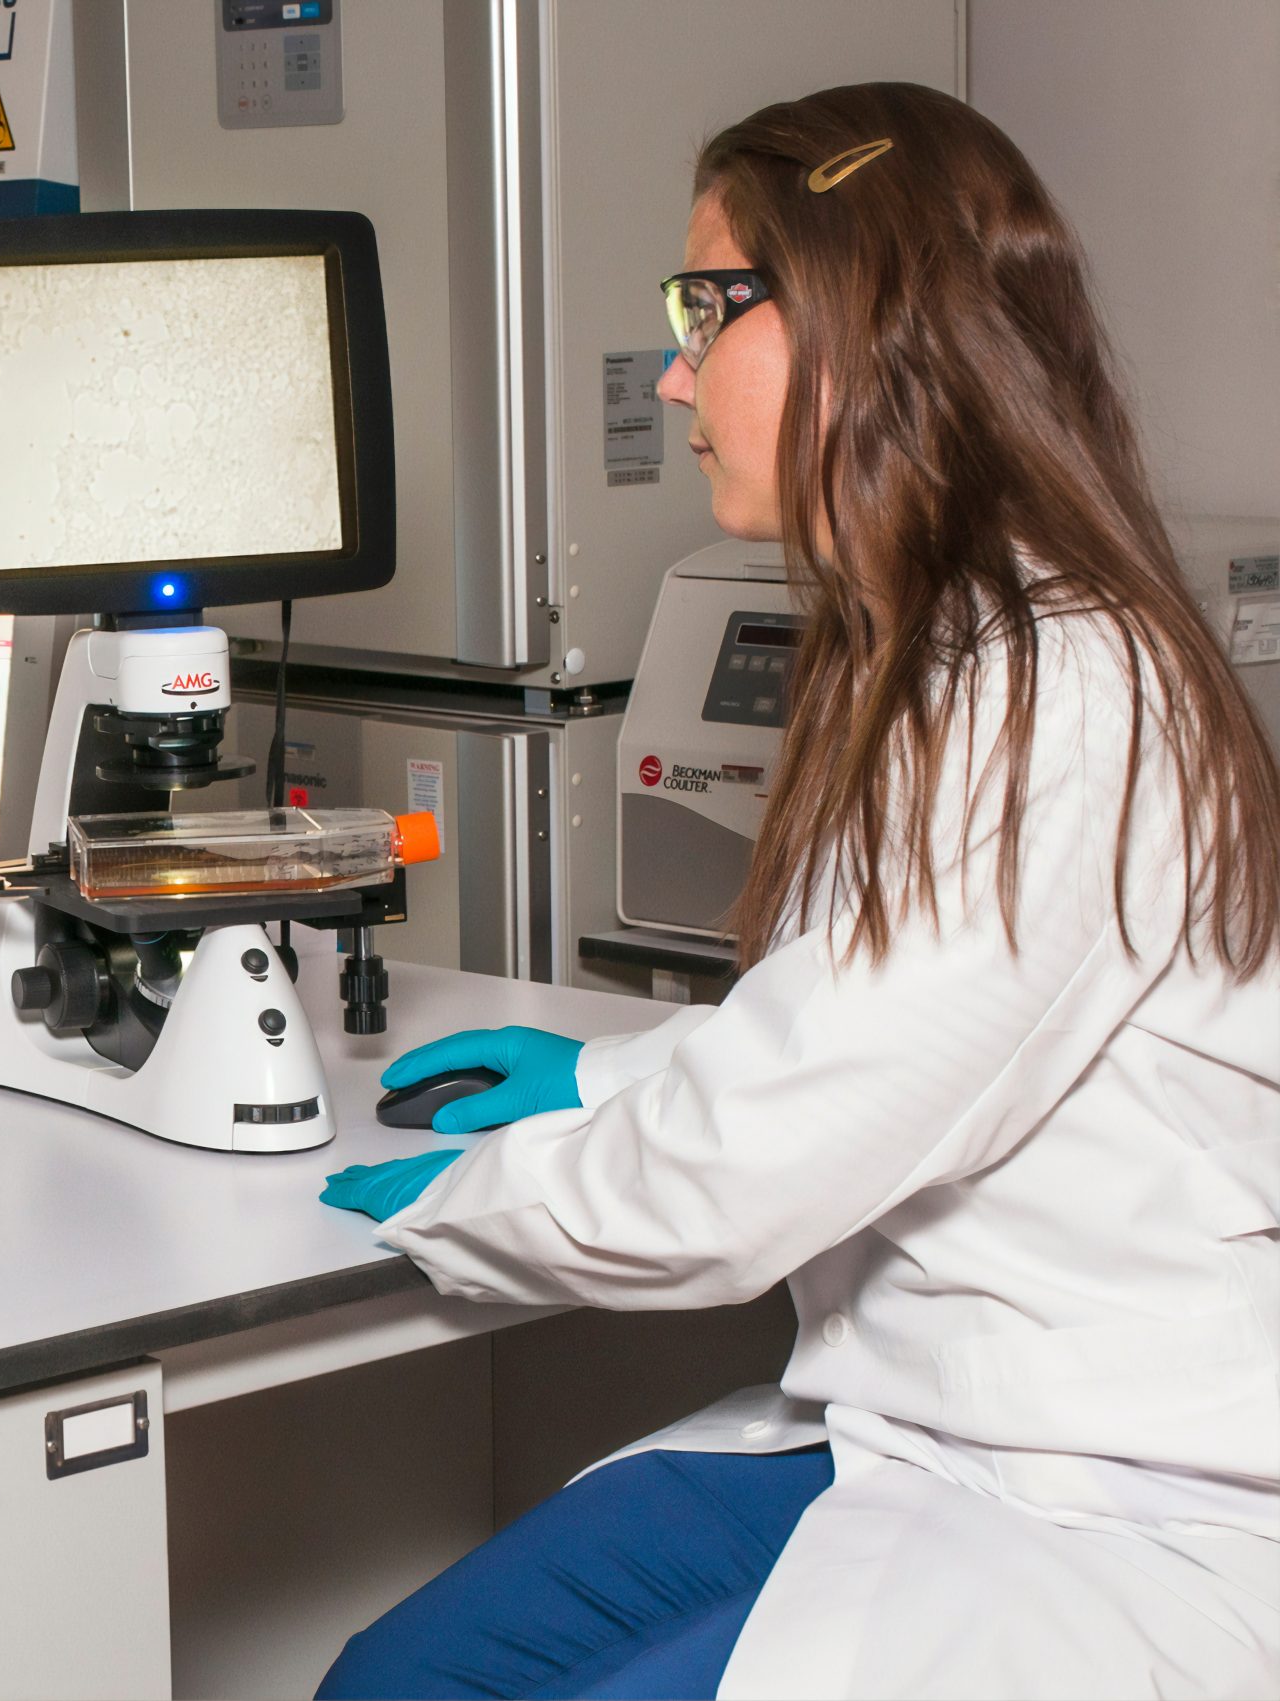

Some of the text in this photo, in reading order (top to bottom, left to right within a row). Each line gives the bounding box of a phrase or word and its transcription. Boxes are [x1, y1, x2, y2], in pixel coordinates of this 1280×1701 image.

[172, 672, 213, 690] AMG
[672, 765, 721, 781] BECKMAN
[663, 777, 709, 793] COULTER
